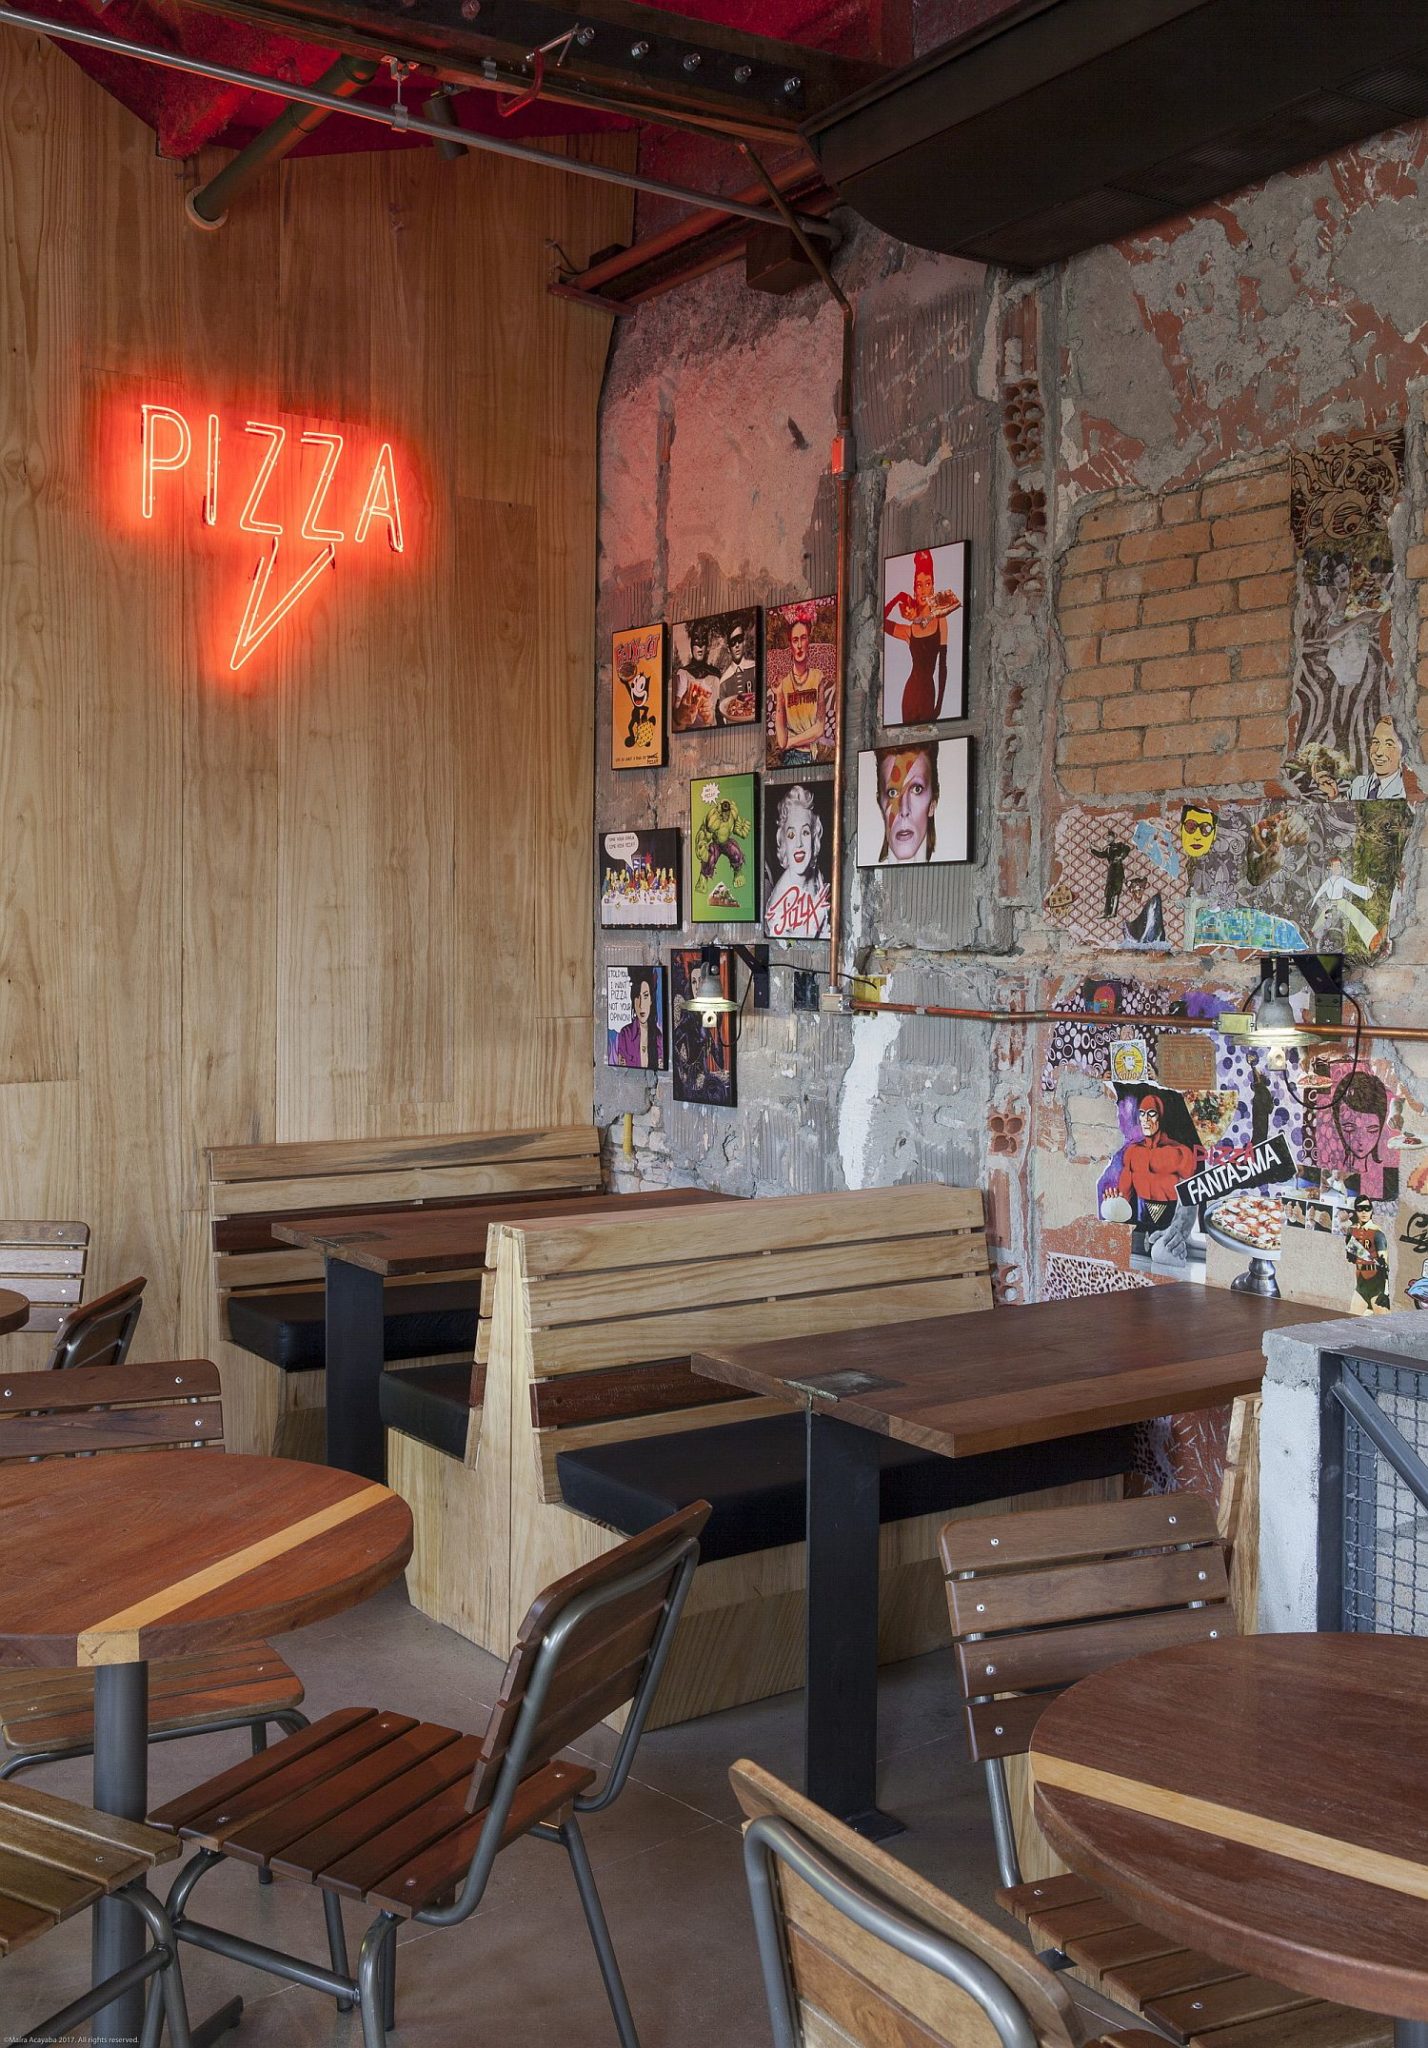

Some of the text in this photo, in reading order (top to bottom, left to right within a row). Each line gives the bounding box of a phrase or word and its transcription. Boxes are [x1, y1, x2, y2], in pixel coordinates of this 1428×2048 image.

[141, 404, 404, 552] PIZZA
[1187, 1143, 1282, 1205] FANTASMA
[1193, 1141, 1256, 1167] PIZZA
